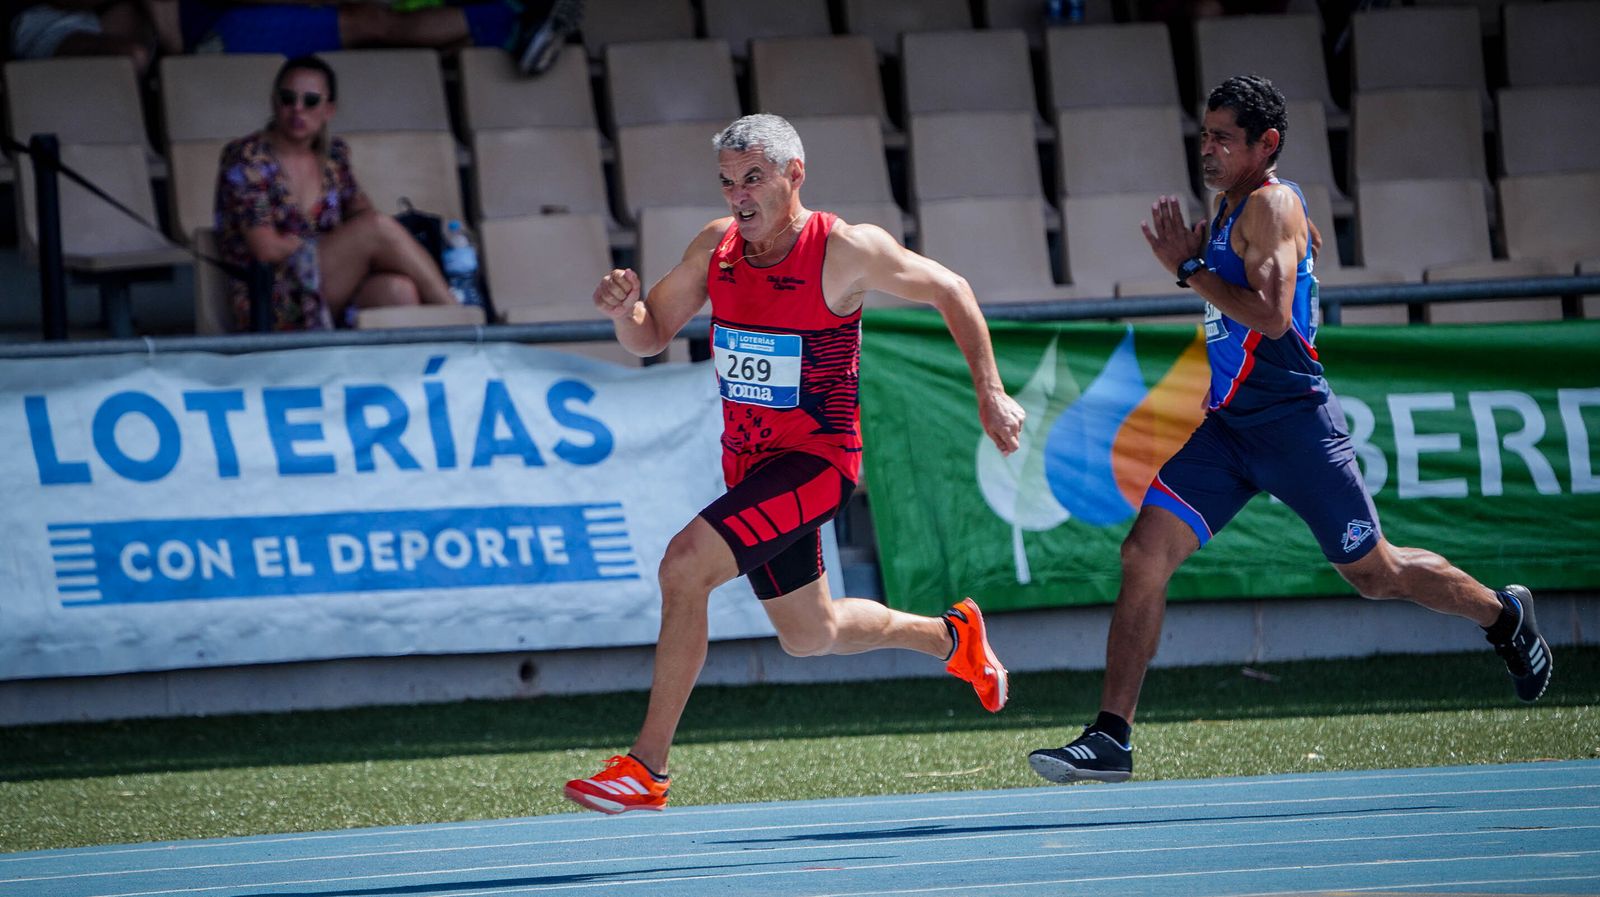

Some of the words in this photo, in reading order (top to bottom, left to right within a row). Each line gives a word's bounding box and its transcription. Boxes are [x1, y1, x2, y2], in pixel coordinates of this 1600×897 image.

[727, 354, 771, 382] 269
[24, 356, 615, 485] LOTERÍAS
[119, 540, 235, 582] CON
[254, 534, 314, 578] EL
[328, 525, 569, 574] DEPORTE
